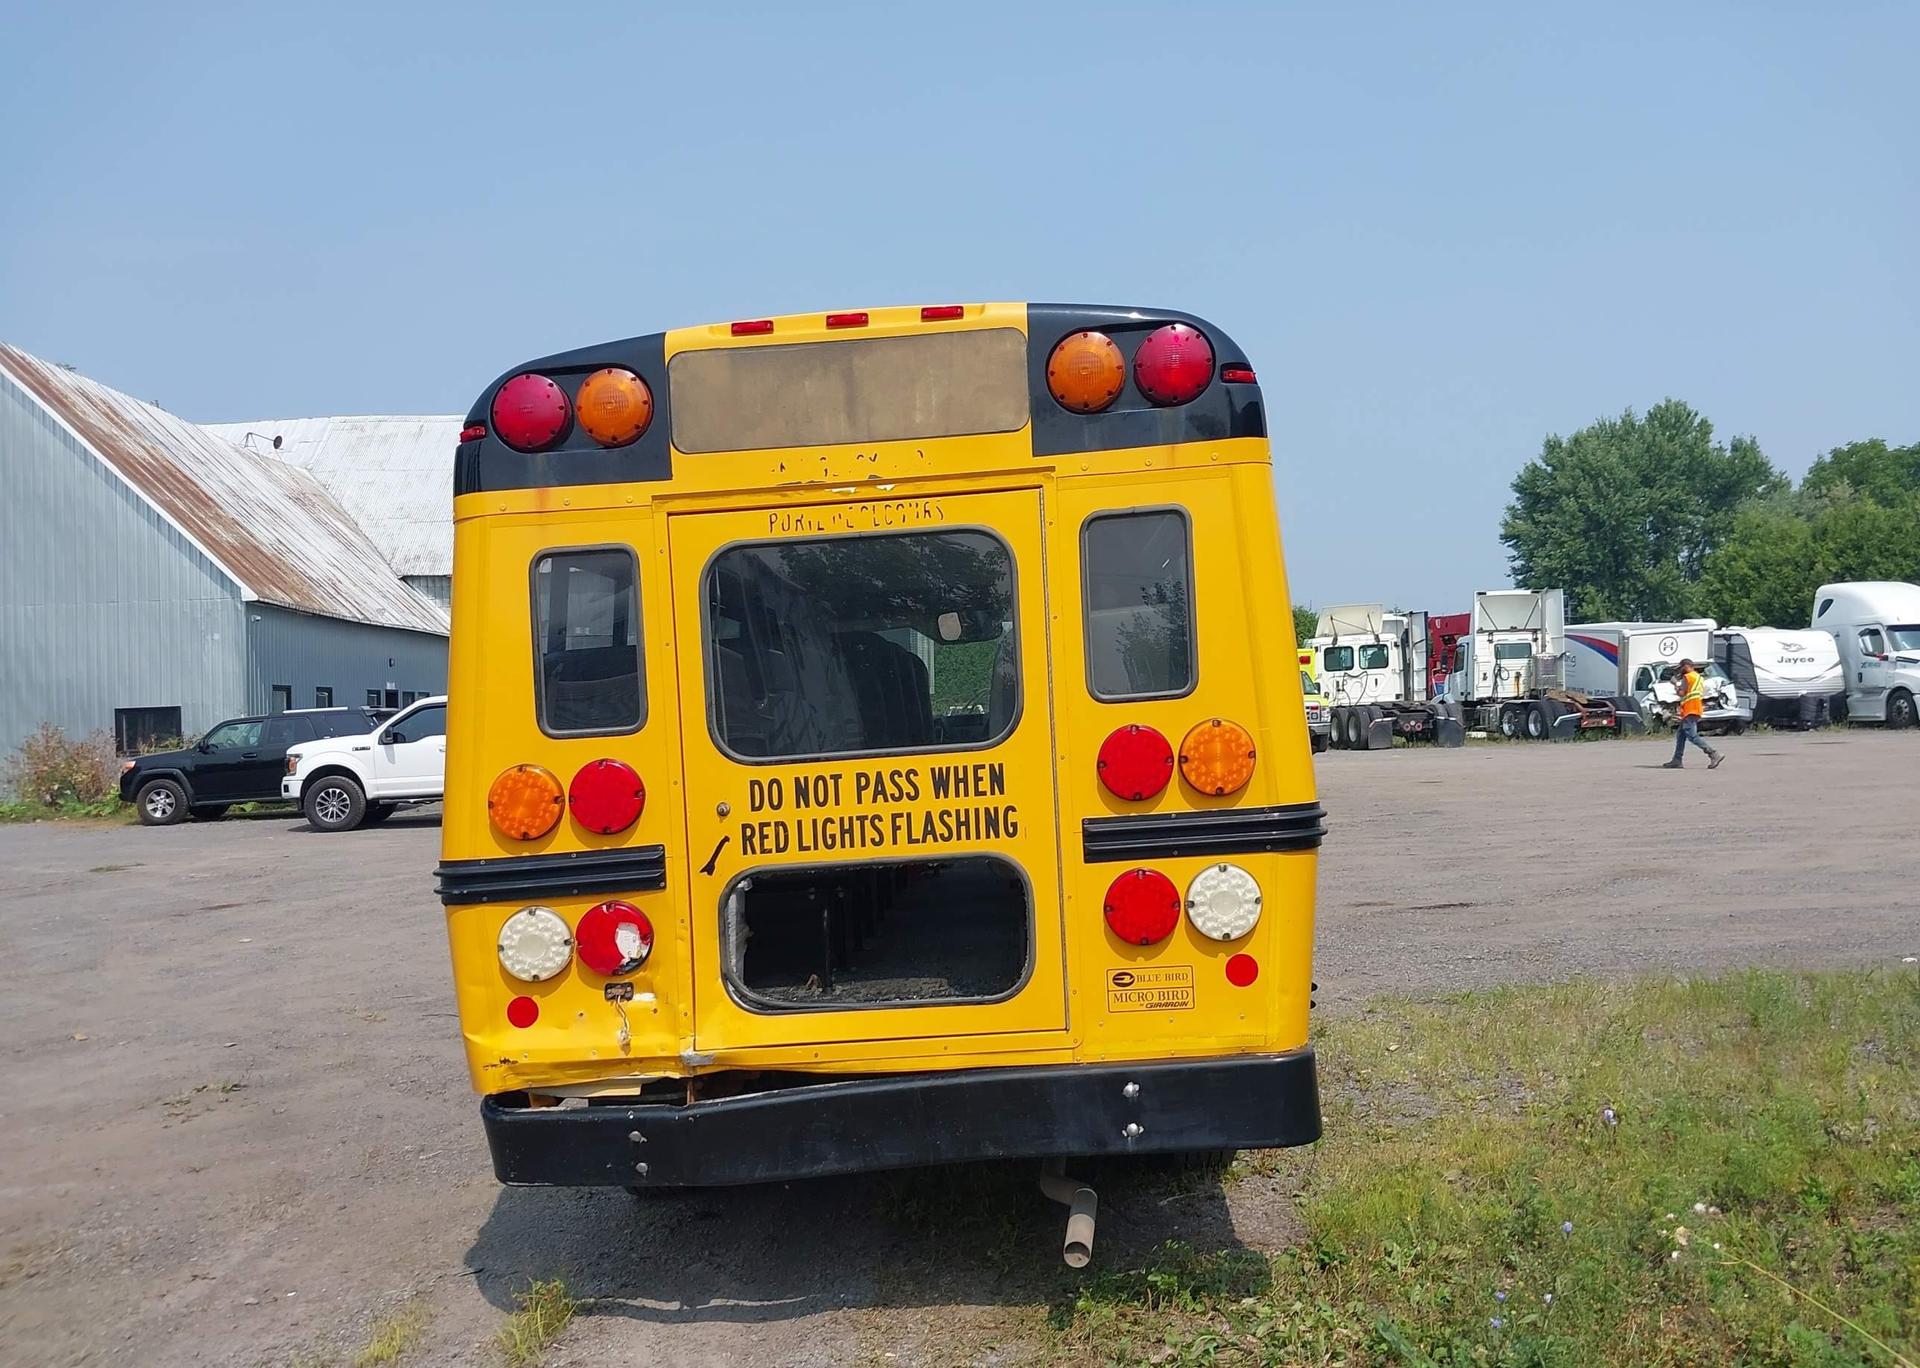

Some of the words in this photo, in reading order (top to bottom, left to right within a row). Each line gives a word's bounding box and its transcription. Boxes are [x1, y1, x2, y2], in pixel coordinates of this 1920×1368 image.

[1776, 655, 1815, 665] Jayco
[749, 778, 783, 812] DO
[794, 773, 843, 809] NOT
[855, 768, 920, 804] PASS
[930, 762, 1005, 799] WHEN
[741, 821, 789, 856] RED
[797, 813, 885, 852] LIGHTS
[891, 805, 1018, 846] FLASHING
[1137, 974, 1161, 983] BLUE
[1164, 973, 1188, 981] BIRD
[1113, 992, 1154, 1003] MICRO
[1158, 990, 1189, 1002] BIRD
